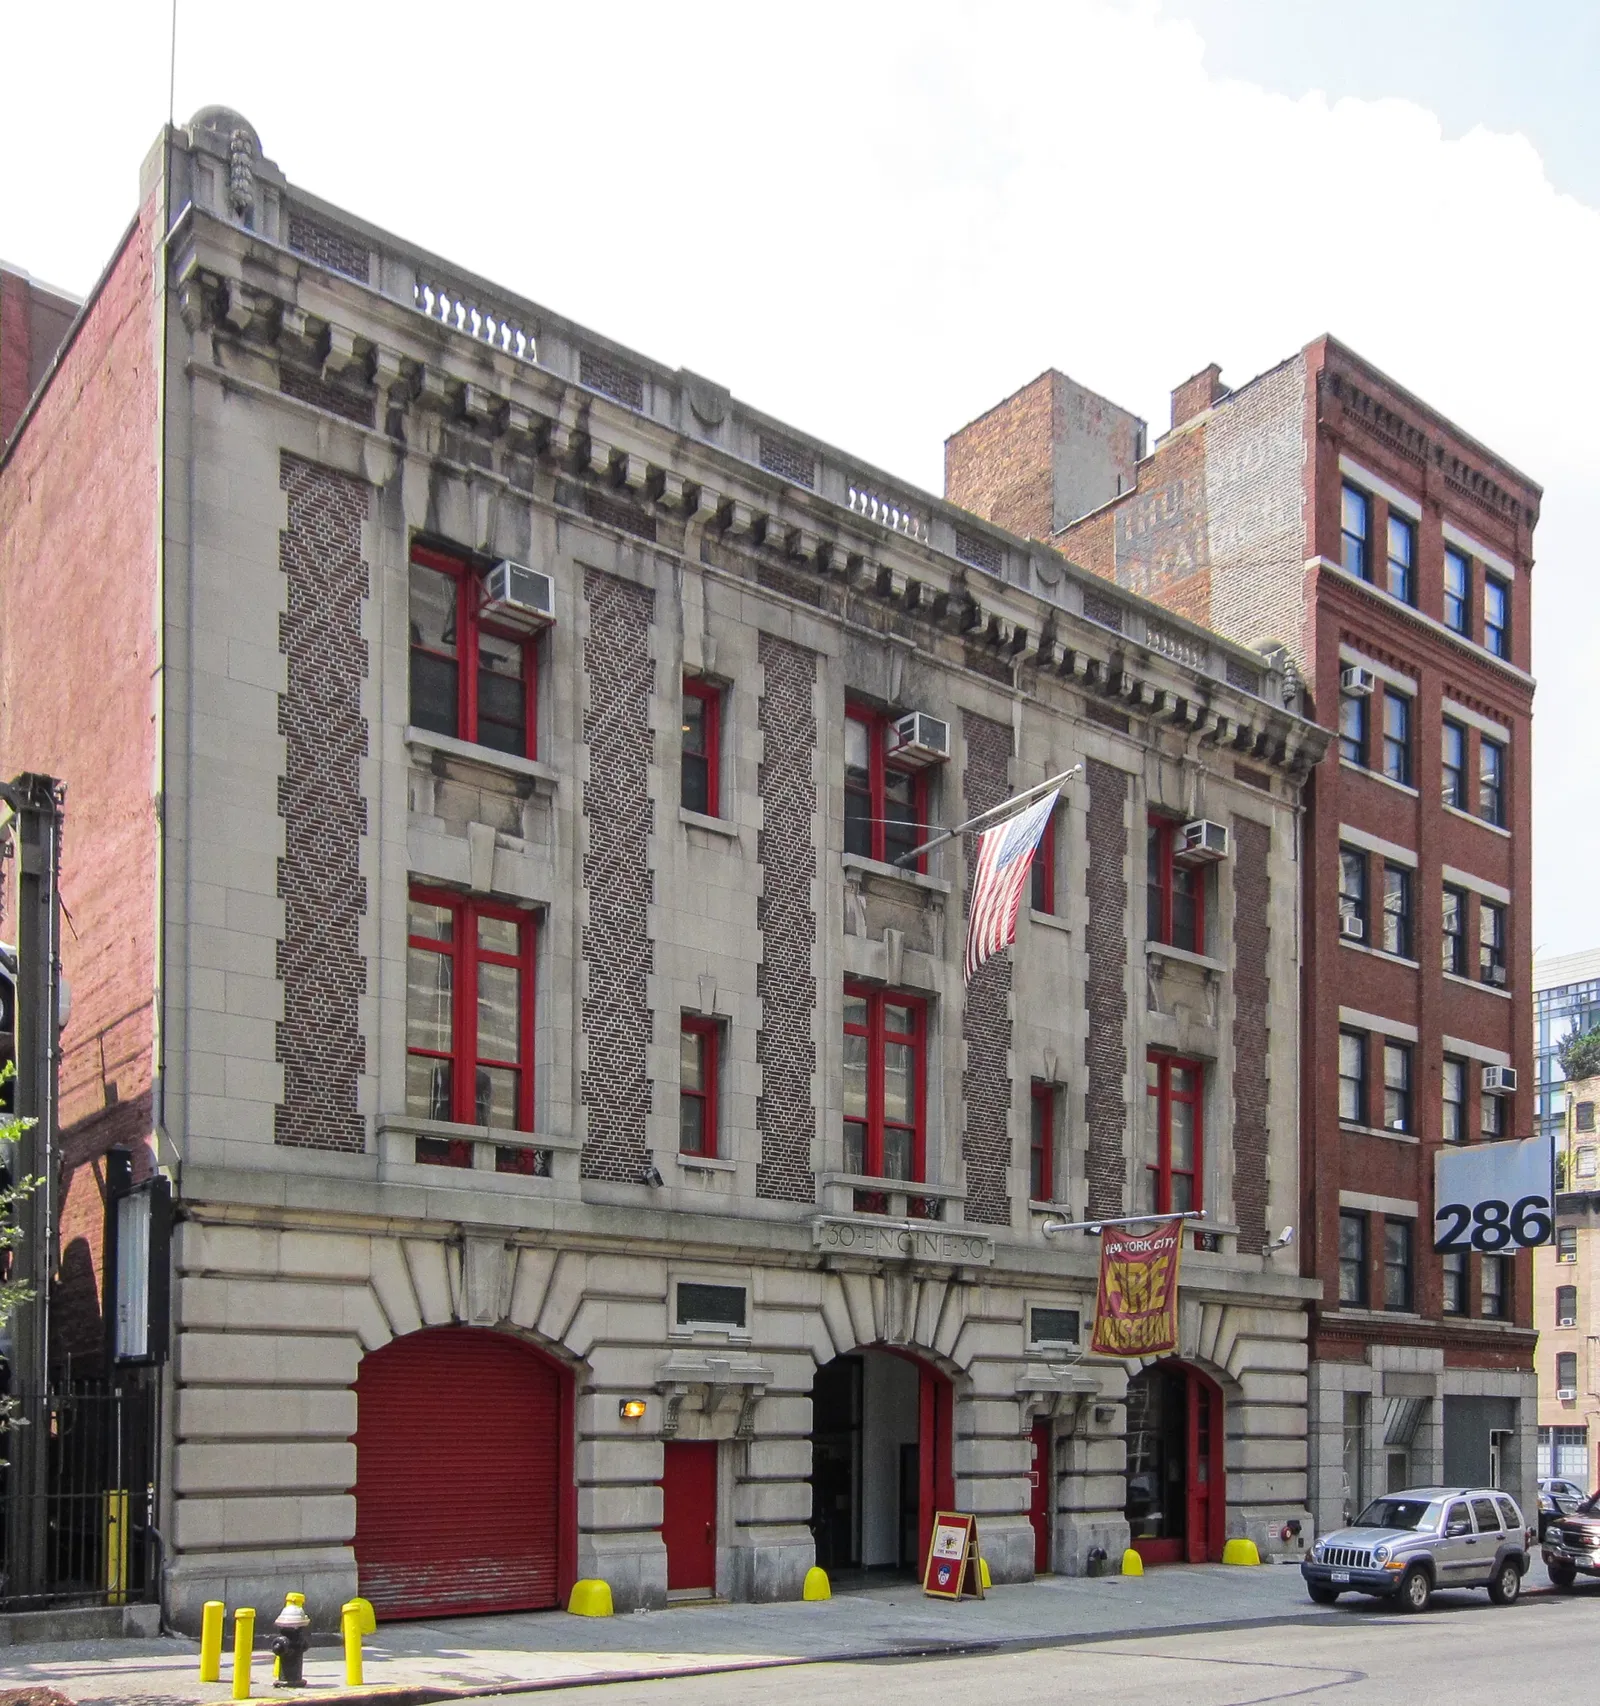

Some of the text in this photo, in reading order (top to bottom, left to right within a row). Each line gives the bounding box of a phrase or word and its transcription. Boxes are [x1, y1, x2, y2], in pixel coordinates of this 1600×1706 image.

[826, 1223, 984, 1259] 30 ENGINE 30
[1434, 1195, 1552, 1255] 286
[1125, 1240, 1152, 1252] YORK
[1153, 1237, 1177, 1250] CITY
[1105, 1255, 1169, 1314] FIRE
[1095, 1311, 1171, 1349] MUSEUM
